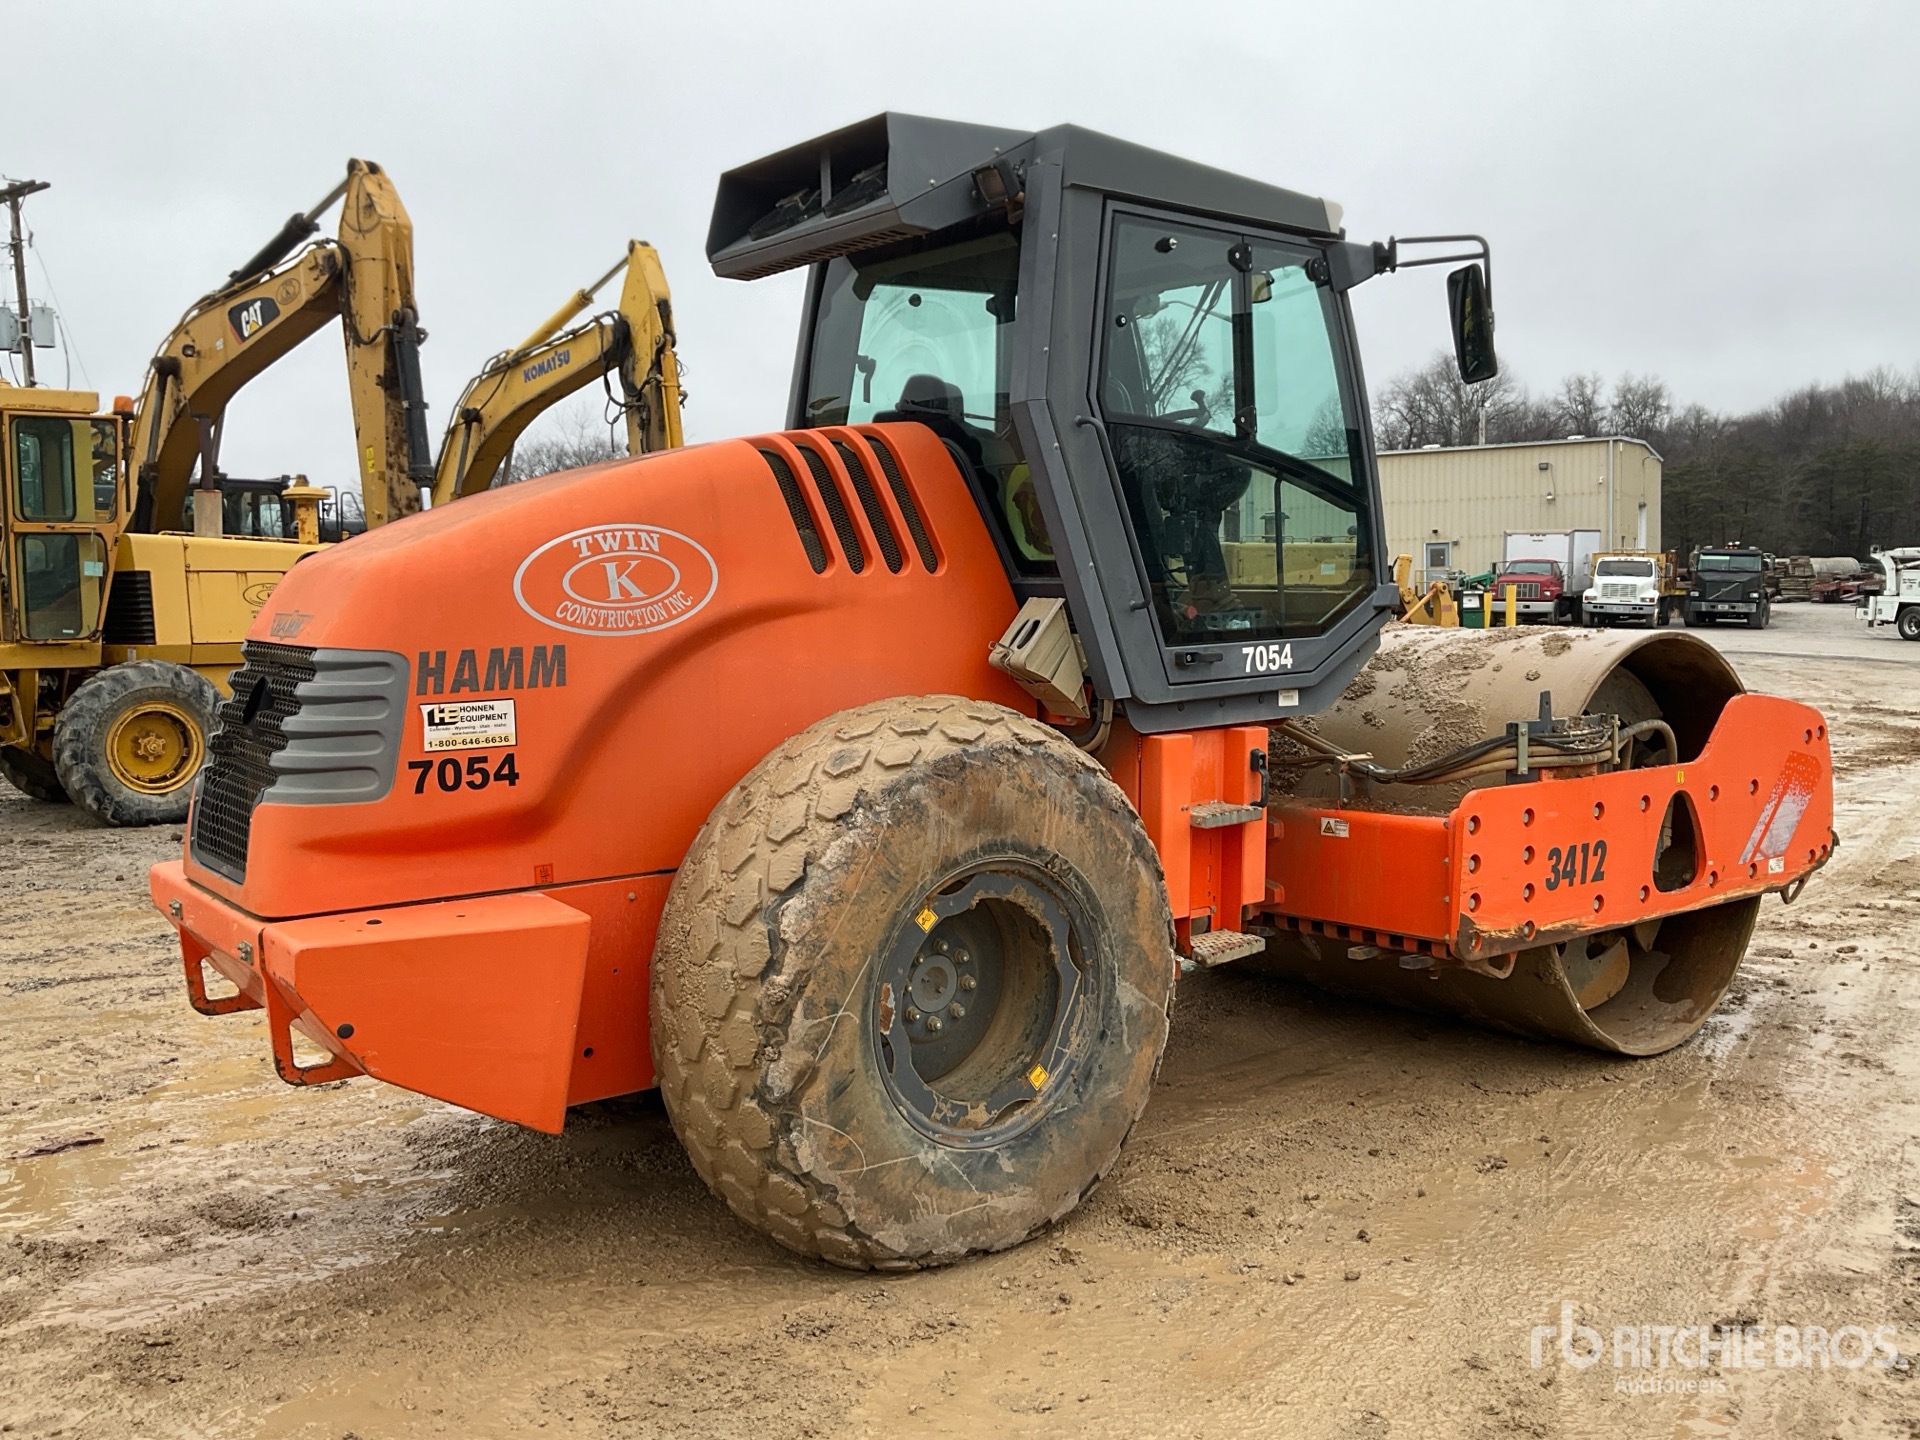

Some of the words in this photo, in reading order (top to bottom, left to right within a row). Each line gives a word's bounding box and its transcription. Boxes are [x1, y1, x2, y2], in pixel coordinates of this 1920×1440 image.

[241, 300, 263, 338] CAT
[523, 349, 570, 384] KOMATSU
[572, 530, 661, 558] TWIN
[600, 559, 649, 601] K
[555, 600, 669, 629] CONSTRUCTION
[665, 589, 694, 615] INC.
[416, 644, 567, 696] HAMM
[1242, 643, 1293, 673] 7054
[459, 704, 495, 713] HONNEN
[460, 712, 508, 723] EQUIPMENT
[428, 735, 510, 748] 1-800-646-6636
[408, 752, 520, 795] 7054
[1545, 839, 1608, 892] 3412
